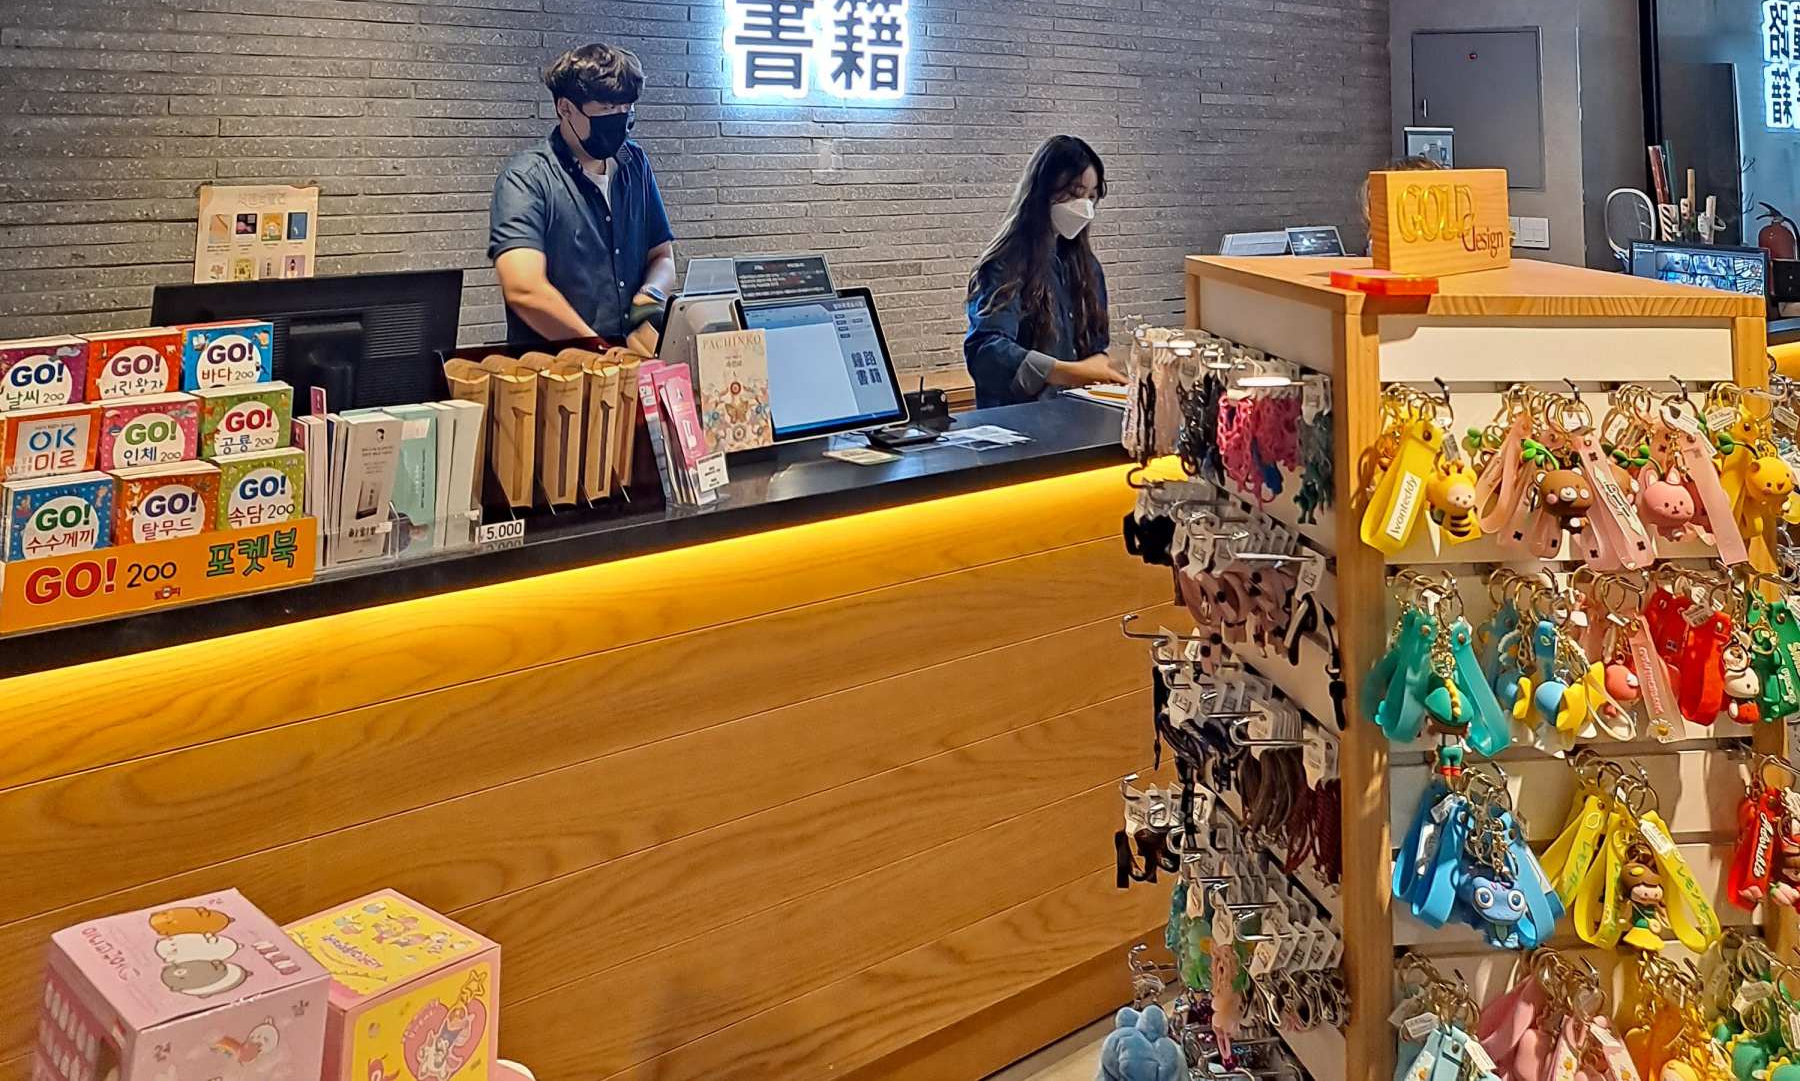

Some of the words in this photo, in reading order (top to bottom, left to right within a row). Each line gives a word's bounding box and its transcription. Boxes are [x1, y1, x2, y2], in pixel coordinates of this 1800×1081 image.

[1397, 184, 1475, 243] GOLD
[1462, 214, 1504, 258] design
[111, 354, 162, 377] GO!
[207, 343, 254, 365] GO!
[11, 362, 65, 387] GO!
[201, 367, 232, 383] 바다
[235, 370, 254, 380] 200
[6, 390, 39, 410] 날씨
[43, 392, 65, 404] 200
[225, 408, 273, 433] GO!
[29, 427, 76, 451] OK
[125, 421, 177, 445] GO!
[219, 434, 252, 455] 공룡
[255, 437, 274, 448] 200
[34, 449, 77, 471] 미로
[124, 446, 157, 467] 인체
[160, 452, 181, 462] 200
[239, 475, 288, 501] GO!
[145, 492, 199, 518] GO!
[228, 503, 264, 527] 속담
[267, 503, 296, 519] 200
[35, 504, 91, 531] GO!
[142, 517, 194, 541] 탈무드
[26, 529, 94, 553] 수수께끼
[24, 556, 119, 606] GO!
[126, 562, 177, 588] 200
[206, 528, 298, 578] 포켓북
